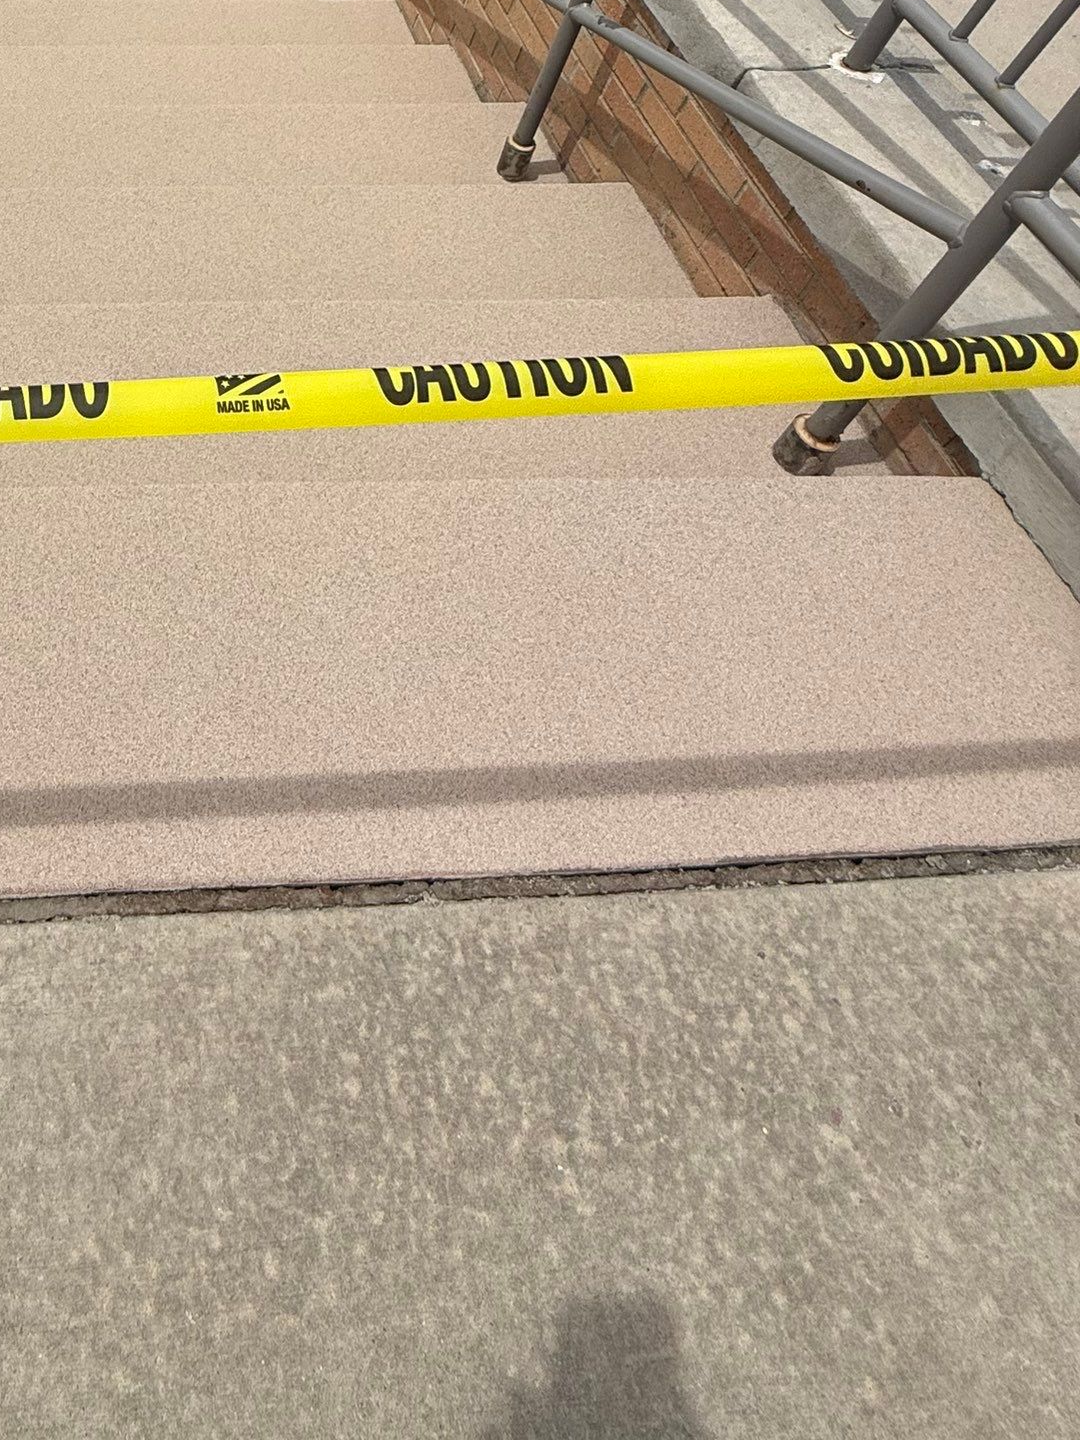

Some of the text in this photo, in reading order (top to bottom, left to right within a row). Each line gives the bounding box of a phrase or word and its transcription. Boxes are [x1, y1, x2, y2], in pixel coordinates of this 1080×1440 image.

[217, 398, 291, 413] MADE IN USA
